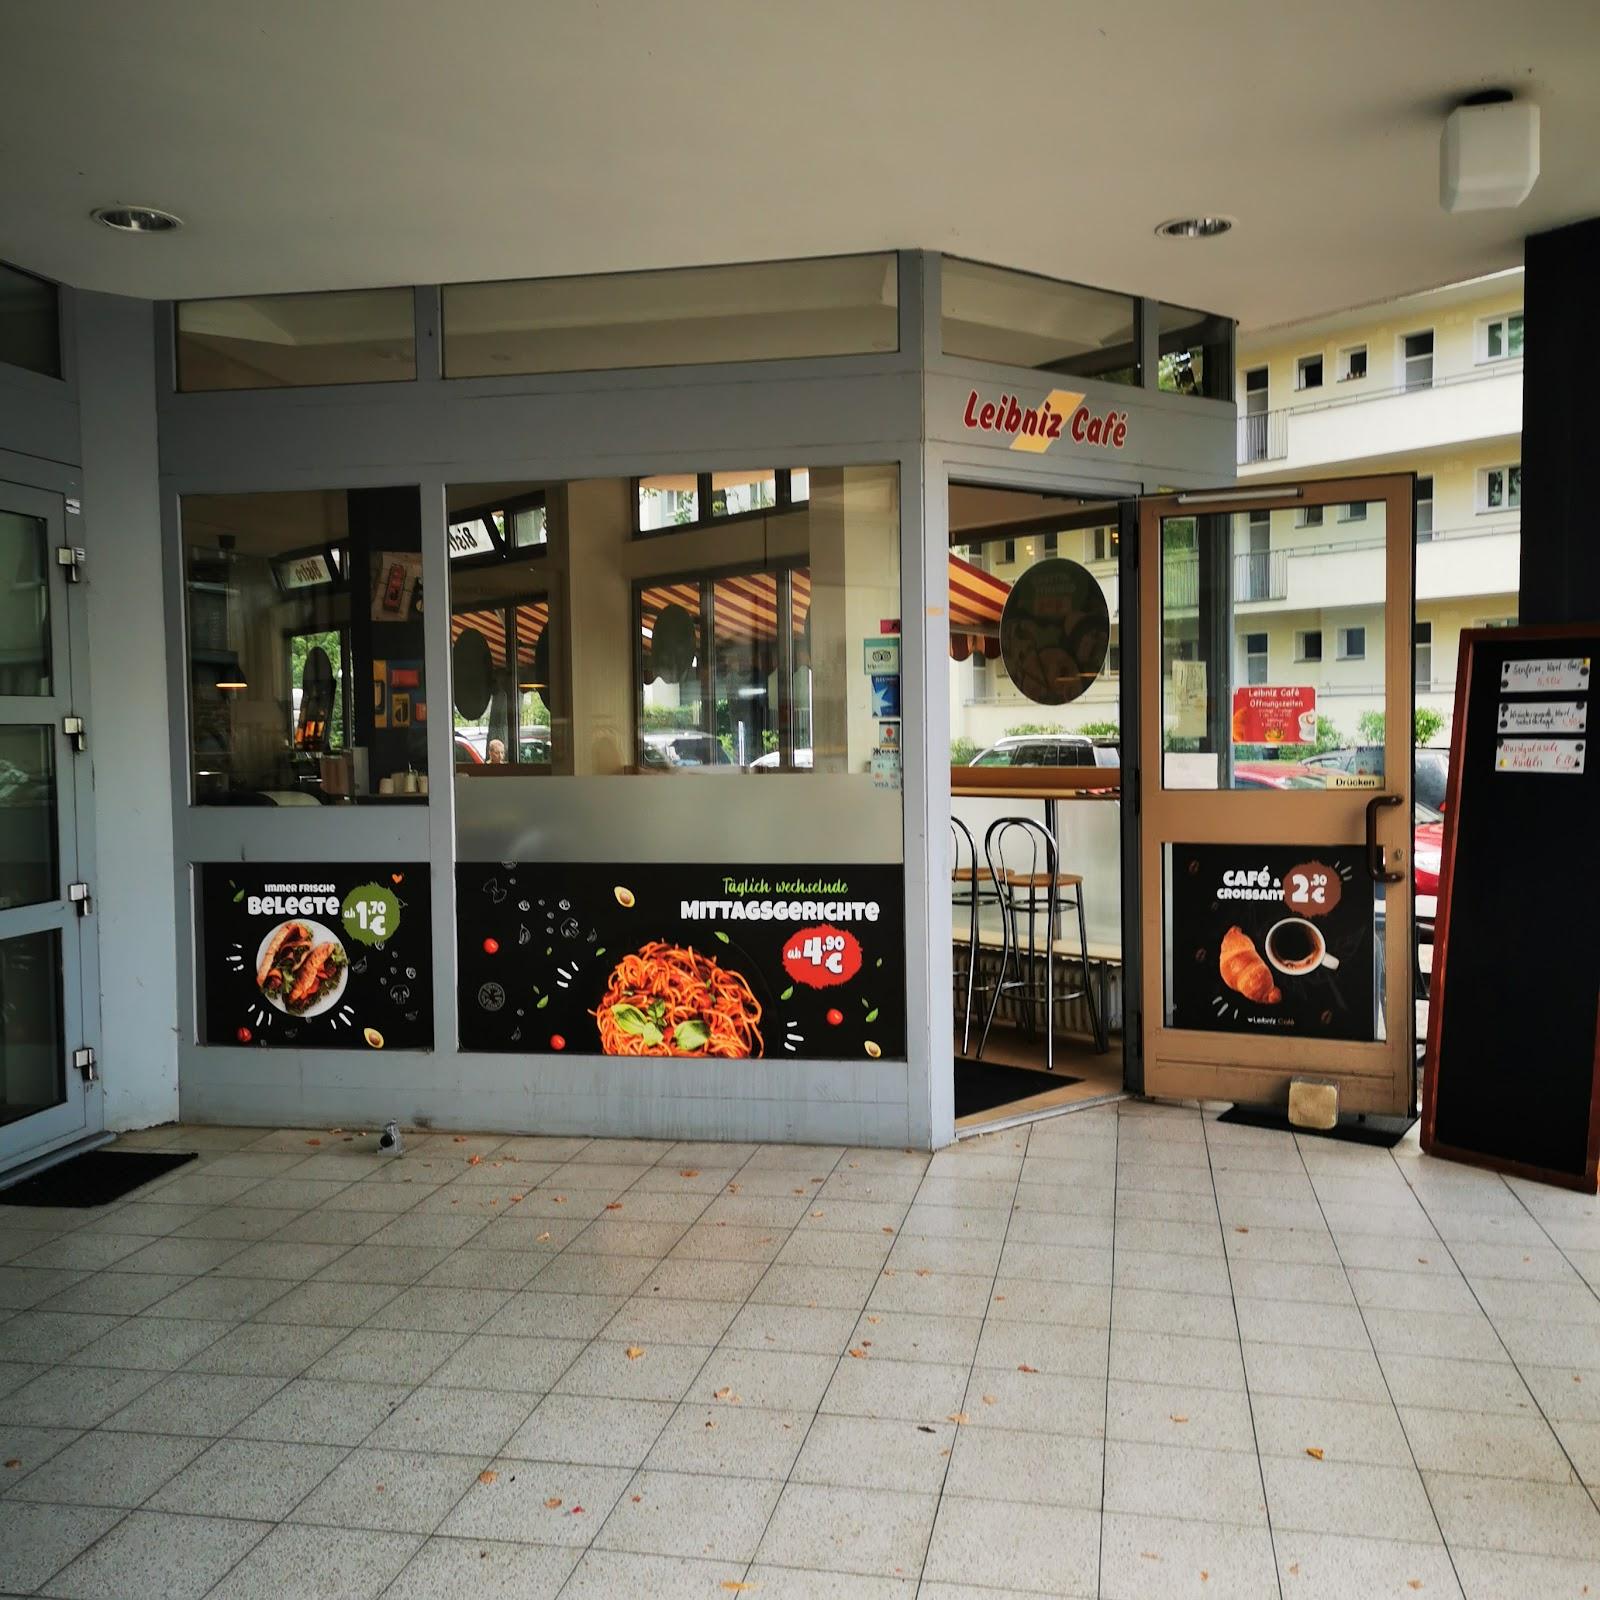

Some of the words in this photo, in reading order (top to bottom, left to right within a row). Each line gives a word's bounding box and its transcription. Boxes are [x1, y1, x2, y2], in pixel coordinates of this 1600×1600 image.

[963, 389, 1063, 439] Leibniz
[1071, 405, 1128, 448] Café
[1248, 688, 1278, 698] Leibniz
[1280, 688, 1300, 698] Café
[1335, 777, 1375, 787] Drücken
[1223, 865, 1271, 888] CAFÉ
[299, 884, 336, 893] FRISCHE
[722, 876, 771, 897] Täglich
[775, 877, 849, 895] wechselnde
[1216, 887, 1285, 901] CROISSANT
[247, 896, 340, 916] BELEGTE
[343, 907, 356, 919] ab
[680, 900, 881, 922] MITTAGSGERICHTE
[787, 946, 802, 960] ab
